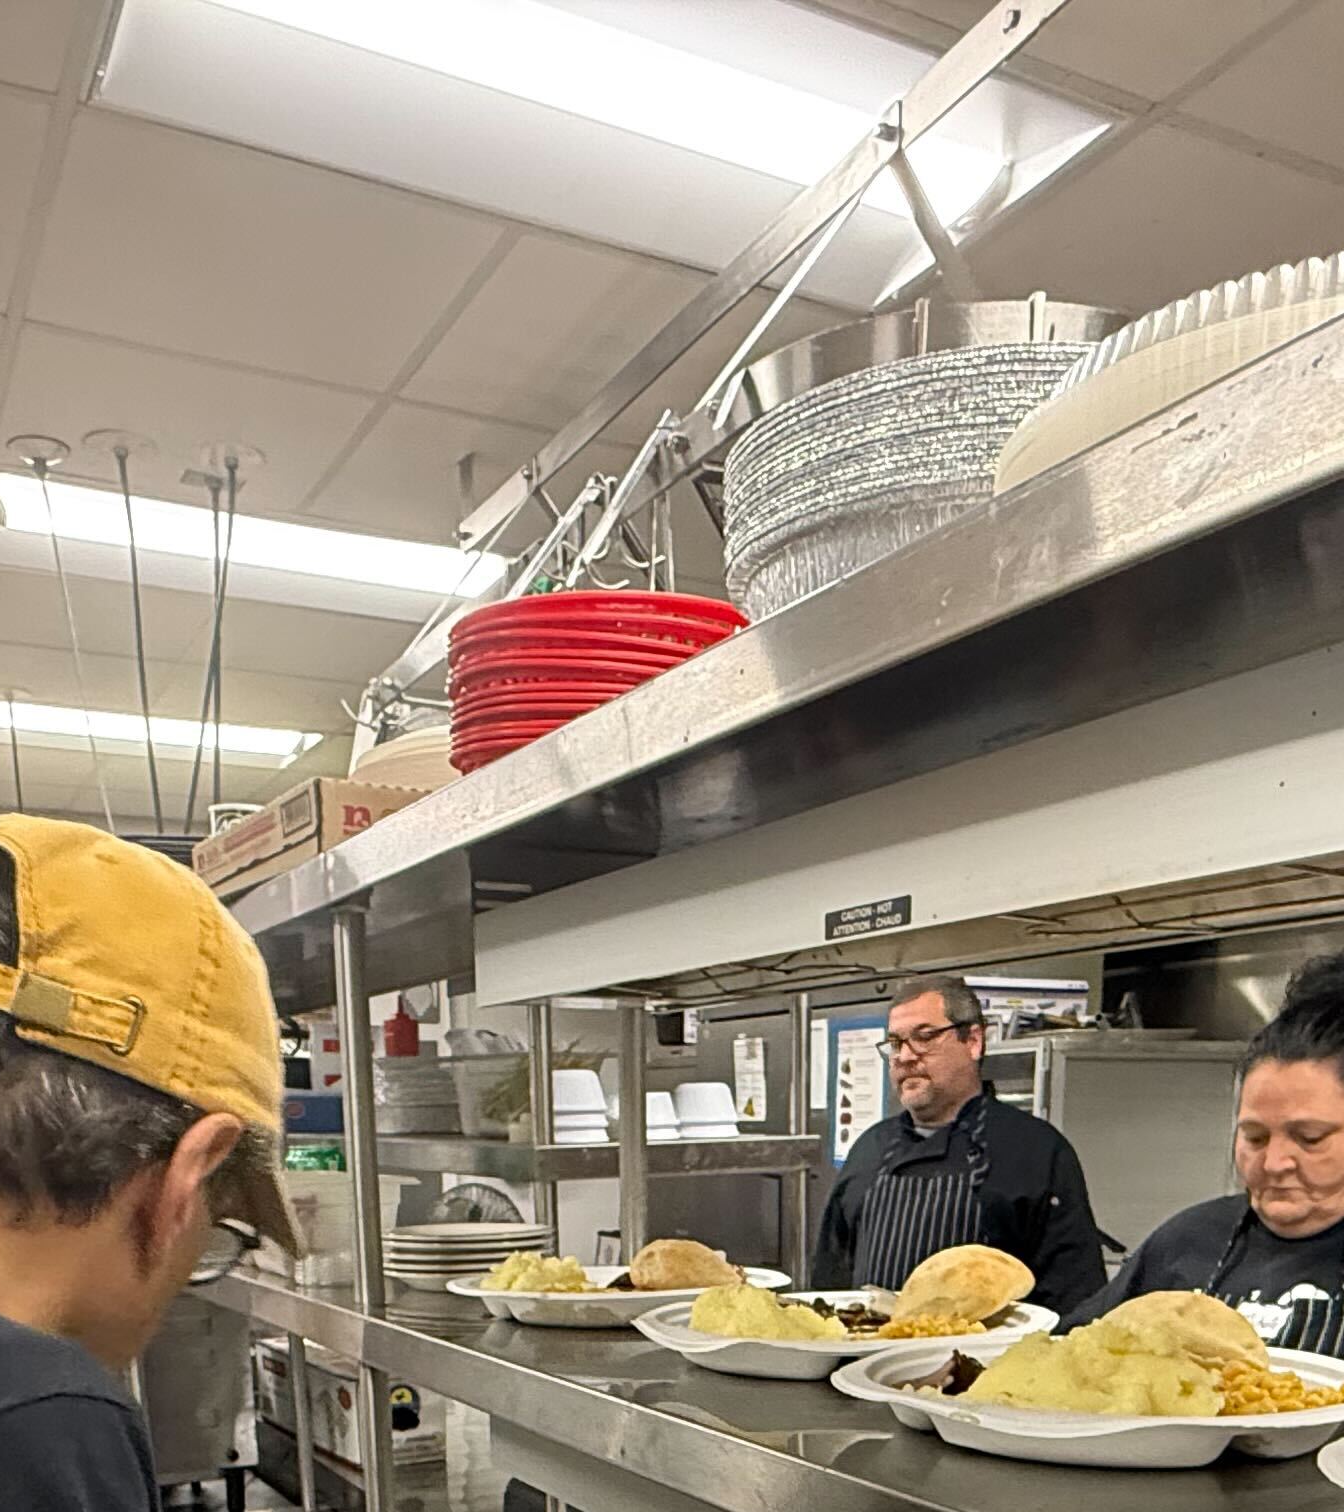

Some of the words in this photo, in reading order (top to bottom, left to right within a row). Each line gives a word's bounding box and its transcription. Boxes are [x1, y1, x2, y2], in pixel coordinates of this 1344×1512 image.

[840, 905, 873, 922] CAUTION
[877, 901, 894, 915] HOT
[832, 919, 871, 937] ATTENTION
[875, 912, 903, 929] CHAUD
